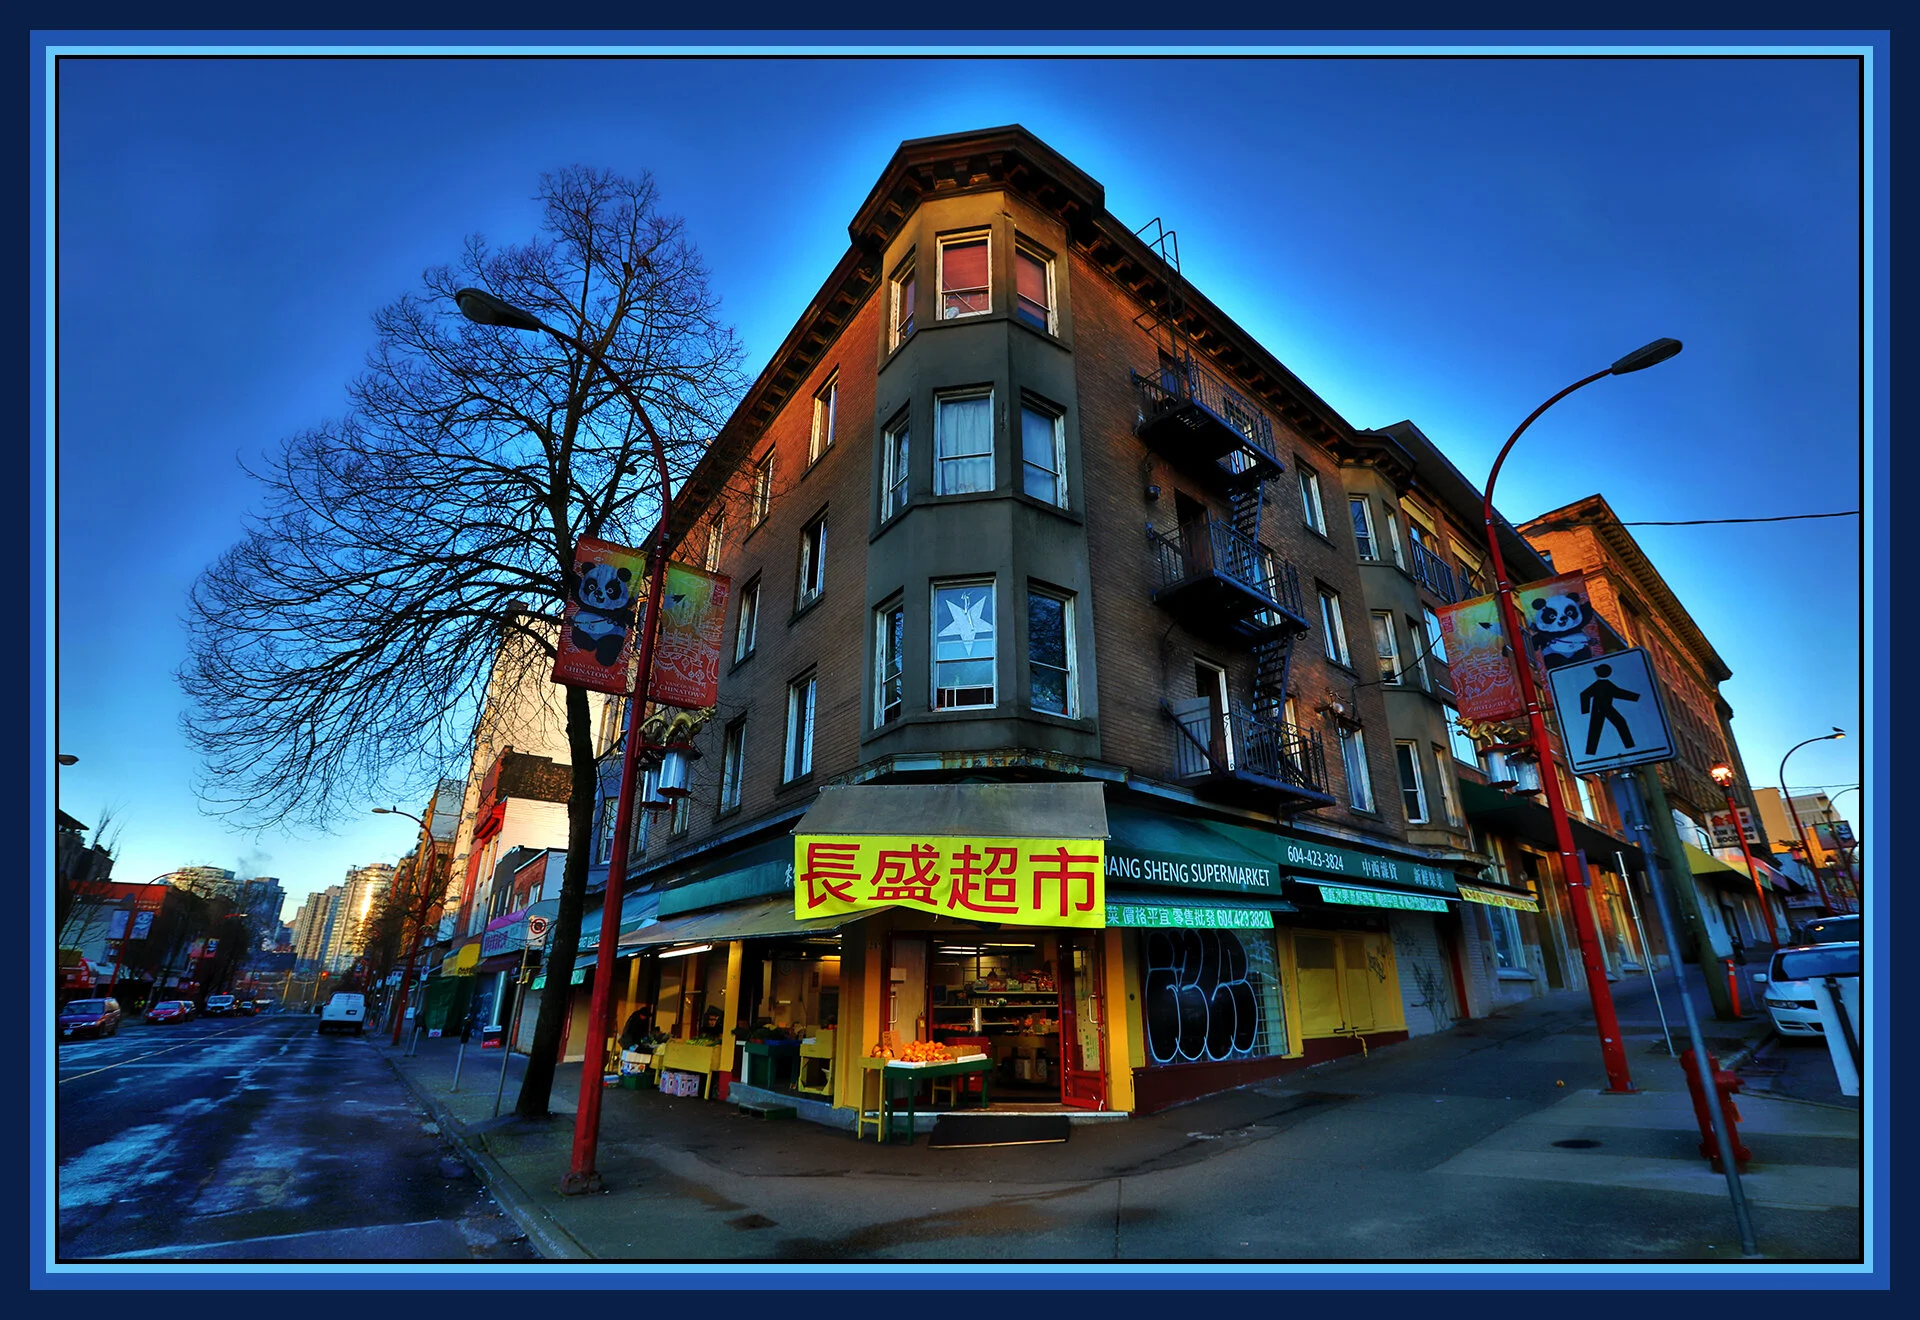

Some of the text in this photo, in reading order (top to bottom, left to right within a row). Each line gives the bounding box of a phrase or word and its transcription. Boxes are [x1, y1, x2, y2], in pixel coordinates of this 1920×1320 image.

[564, 664, 615, 680] CHINATOWN
[659, 684, 706, 699] CHINATOWN
[1717, 834, 1755, 844] NOODES
[1287, 845, 1344, 872] 604-423-3824
[800, 843, 1099, 916] 長盛超市
[1104, 855, 1271, 887] ANG SHENG SUPERMARKET
[1217, 908, 1233, 927] 604
[1234, 909, 1249, 927] 423
[1250, 909, 1270, 927] 3824
